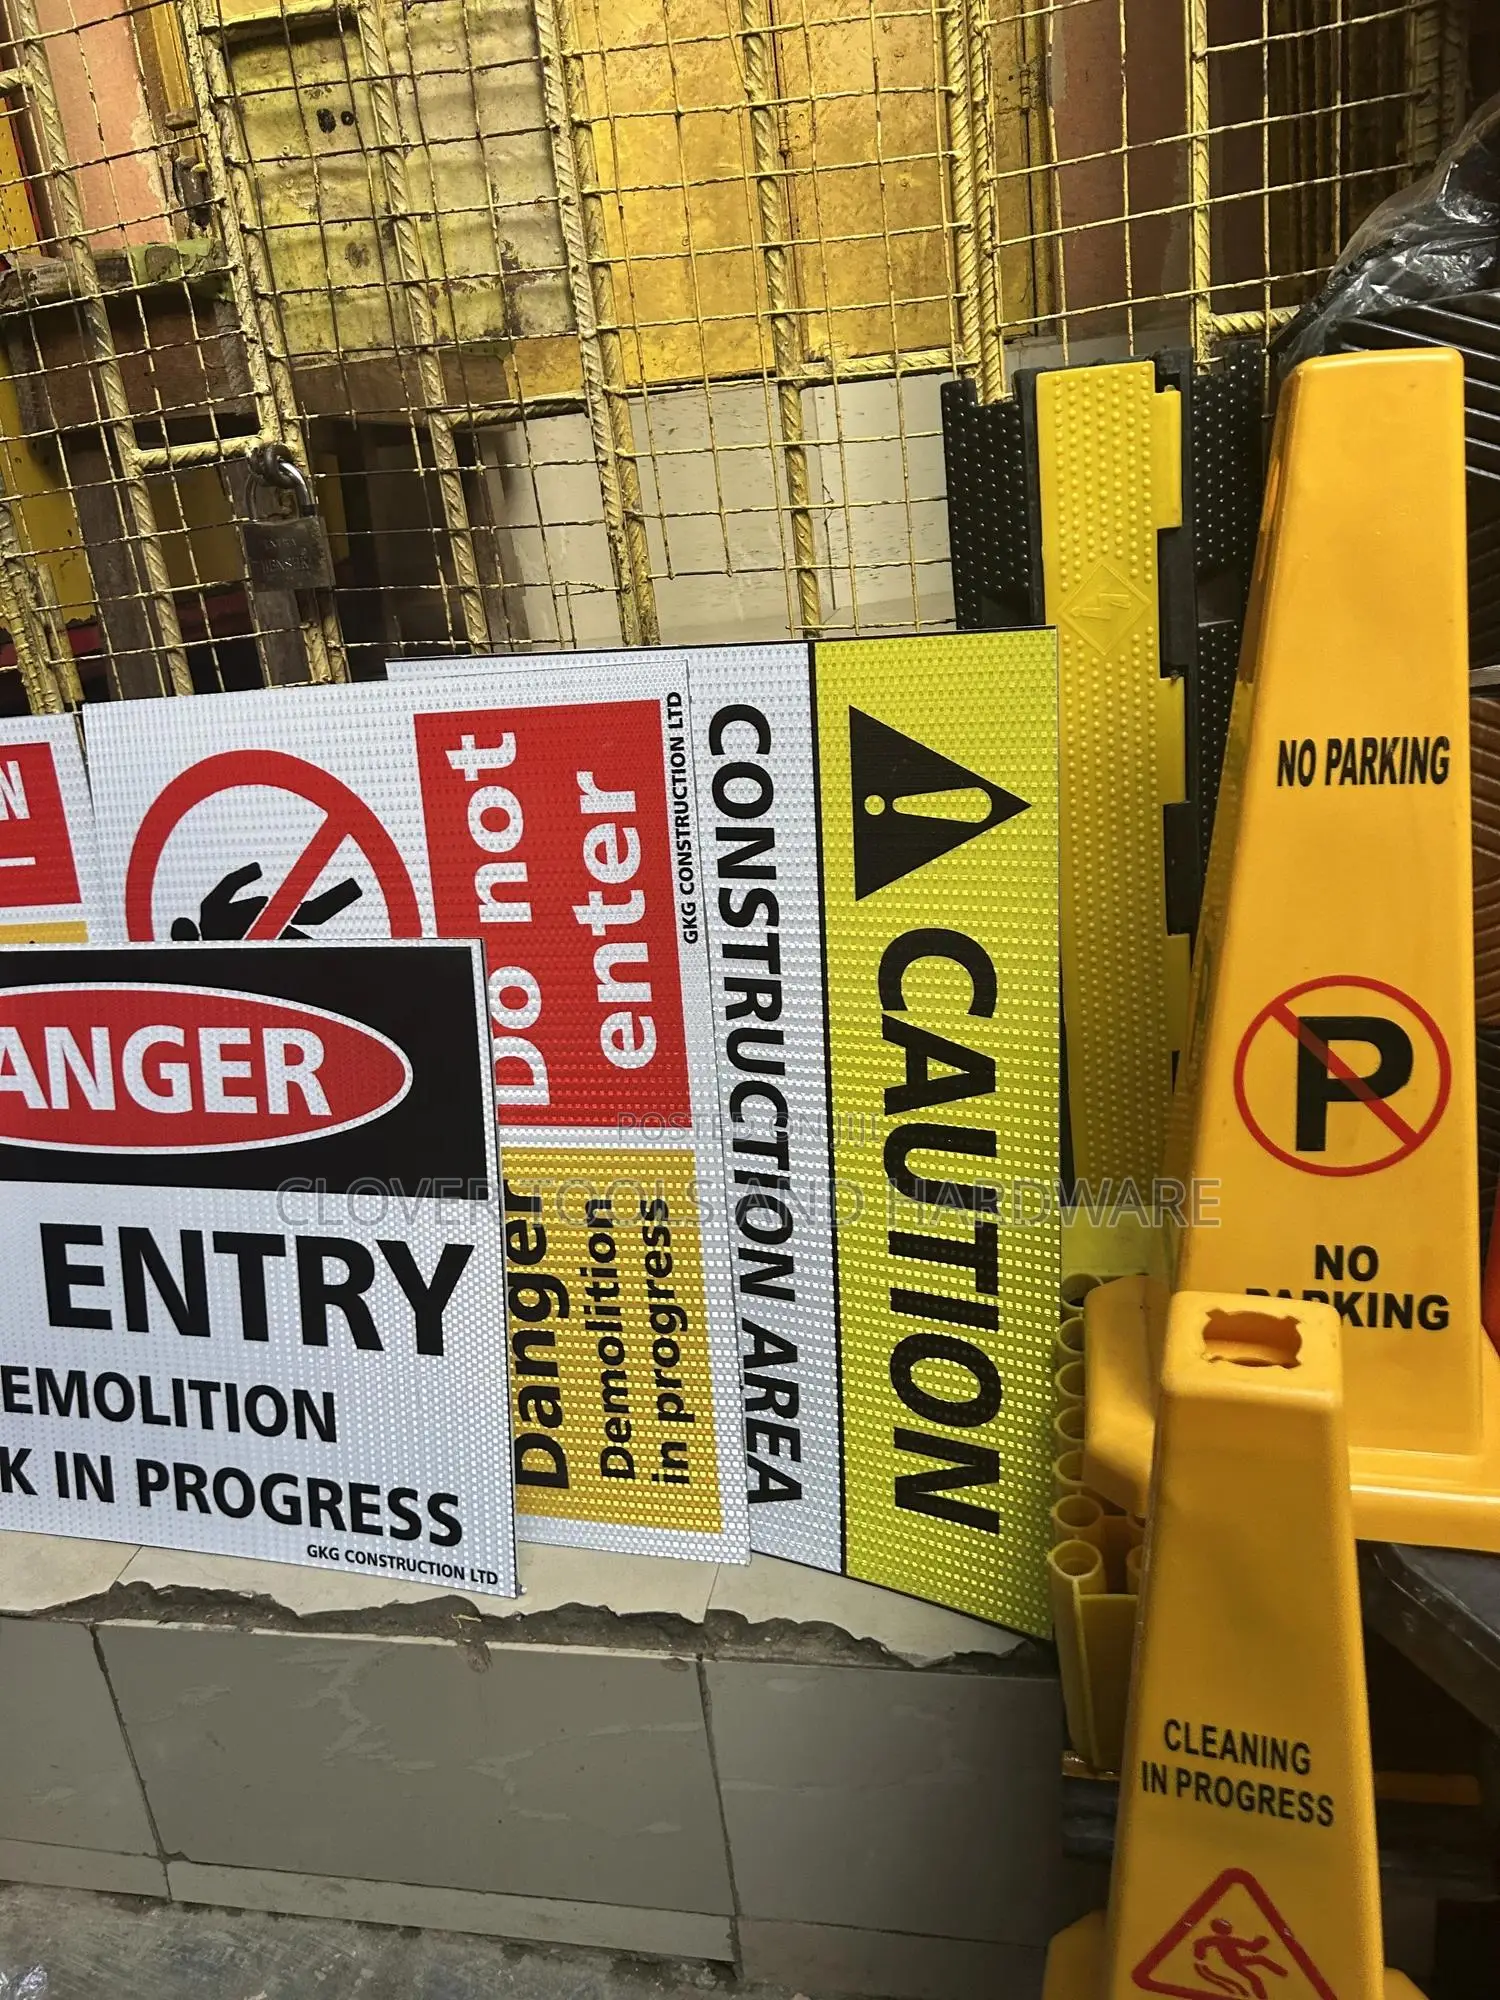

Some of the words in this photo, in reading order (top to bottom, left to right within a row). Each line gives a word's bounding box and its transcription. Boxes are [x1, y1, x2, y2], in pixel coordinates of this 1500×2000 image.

[667, 691, 684, 729] LTD
[1277, 739, 1317, 787] NO
[1325, 735, 1451, 785] PARKING
[445, 731, 532, 923] not
[670, 736, 695, 895] CONSTRUCTION
[572, 771, 657, 1069] enter
[681, 901, 698, 945] GKG
[488, 966, 550, 1105] Do
[709, 703, 795, 1302] CONSTRUCTION
[877, 927, 1003, 1534] CAUTION
[1314, 1244, 1379, 1281] NO
[39, 1222, 475, 1357] ENTRY
[503, 1179, 569, 1490] Danger
[579, 1198, 635, 1480] Demolition
[640, 1198, 695, 1423] progress
[1246, 1288, 1450, 1330] KING
[0, 1365, 338, 1443] EMOLITION
[738, 1316, 803, 1505] AREA
[54, 1450, 115, 1503] IN
[135, 1457, 464, 1547] PROGRESS
[652, 1441, 690, 1485] in
[306, 1544, 340, 1561] GKG
[344, 1549, 465, 1581] CONSTRUCTION
[470, 1568, 499, 1586] LTD
[1141, 1760, 1168, 1795] IN
[1175, 1766, 1336, 1828] PROGRESS
[1163, 1718, 1311, 1776] CLEANING
